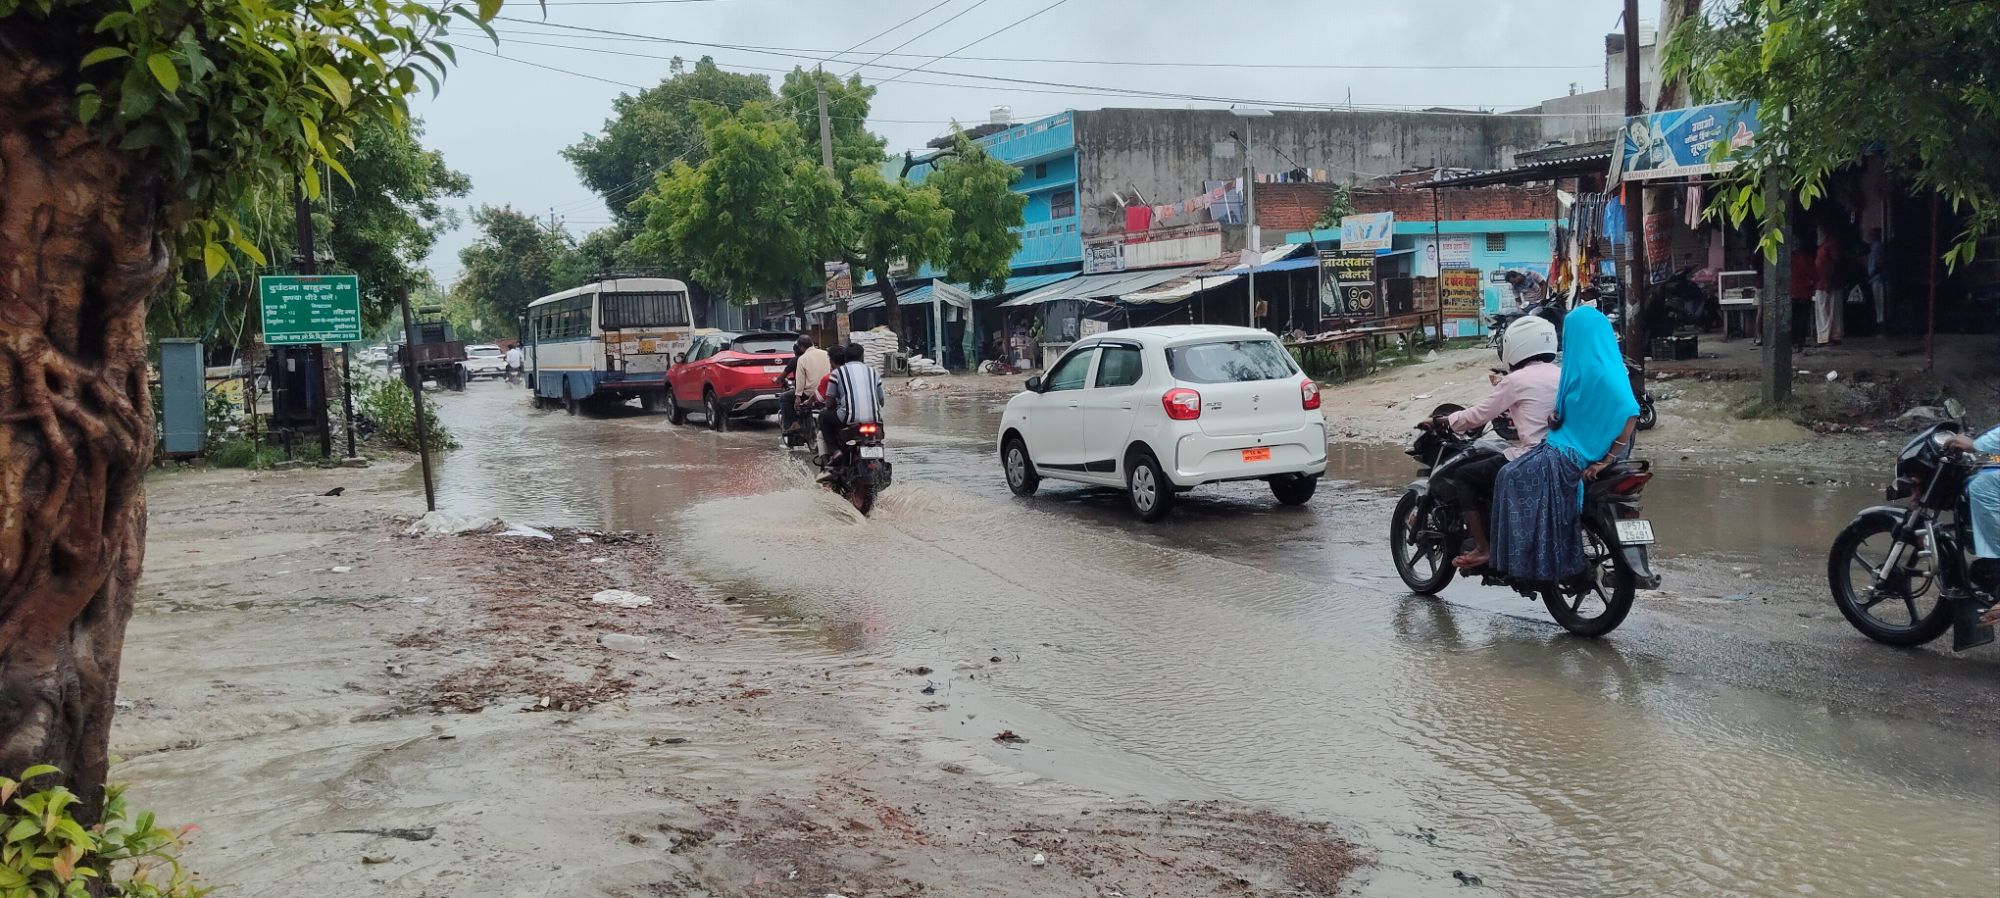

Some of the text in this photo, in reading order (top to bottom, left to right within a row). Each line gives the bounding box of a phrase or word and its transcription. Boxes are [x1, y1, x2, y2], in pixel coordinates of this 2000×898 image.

[1691, 115, 1715, 132] उठाओ
[1628, 171, 1651, 179] SUNNY
[1673, 167, 1688, 176] AND
[1689, 165, 1706, 174] FAST
[1707, 163, 1727, 172] FOD
[1321, 257, 1375, 267] जायसवाल
[269, 282, 299, 294] दुर्घटना
[302, 284, 332, 293] बाहुल्य
